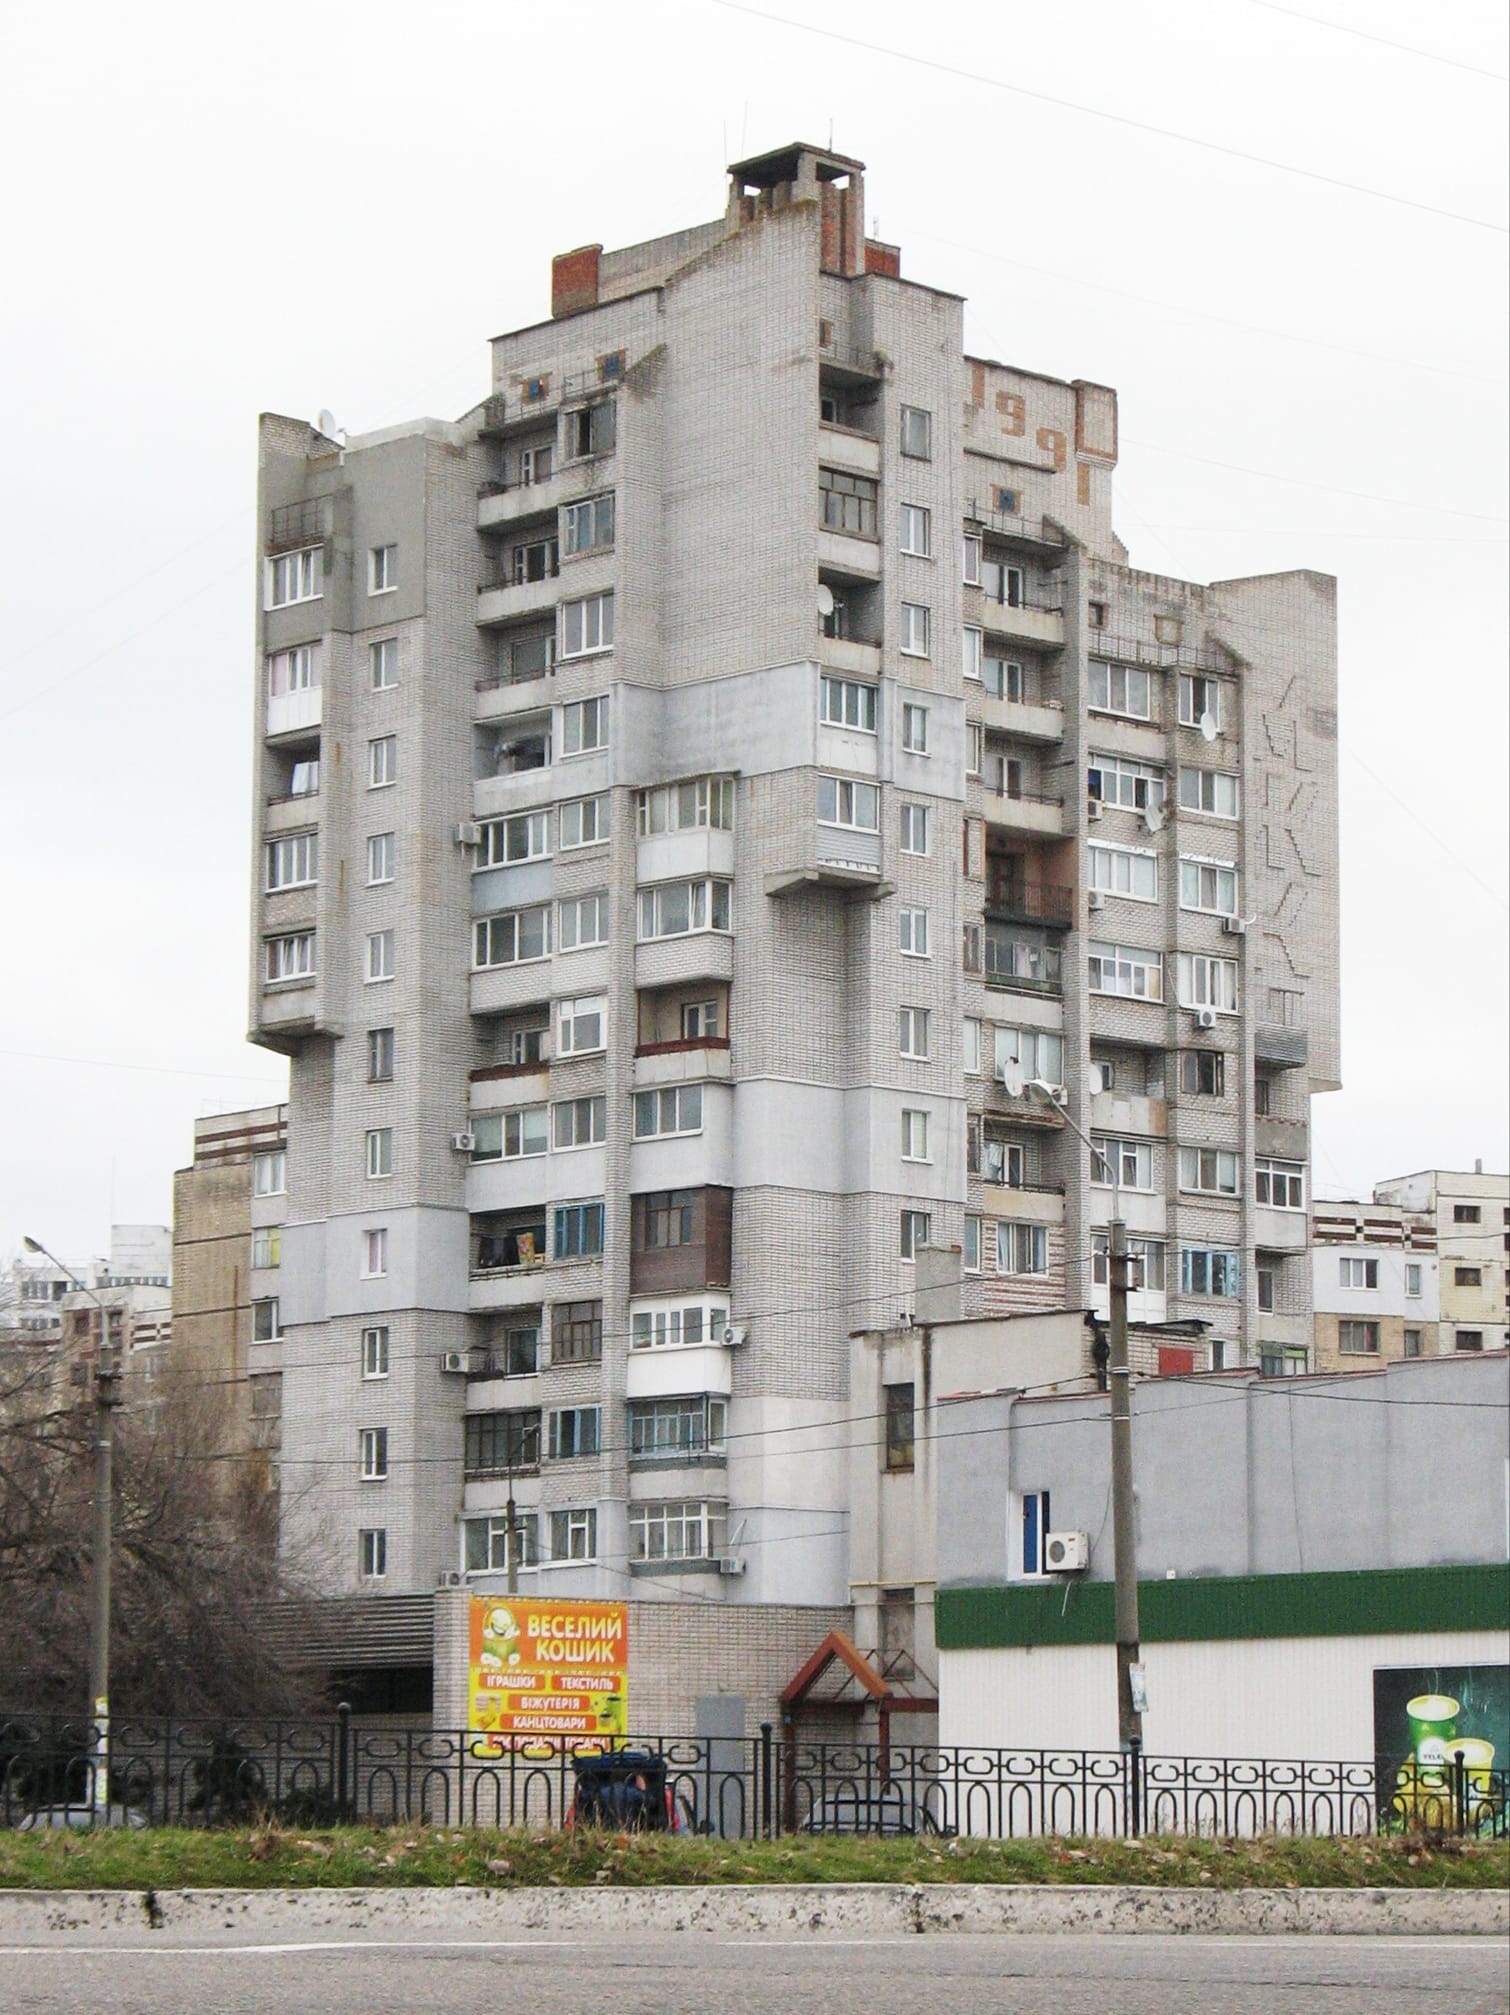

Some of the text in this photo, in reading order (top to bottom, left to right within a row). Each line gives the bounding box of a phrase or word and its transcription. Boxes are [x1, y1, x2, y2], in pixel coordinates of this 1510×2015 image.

[527, 1612, 622, 1639] ВЕСЕЛИЙ
[536, 1638, 615, 1663] КОШИК
[487, 1675, 536, 1688] ІГРАШКИ
[560, 1677, 614, 1690] ТЕКСТИЛЬ
[521, 1696, 580, 1710] БІЖУТЕРІЯ
[513, 1716, 586, 1729] КАНЦТОВАРИ
